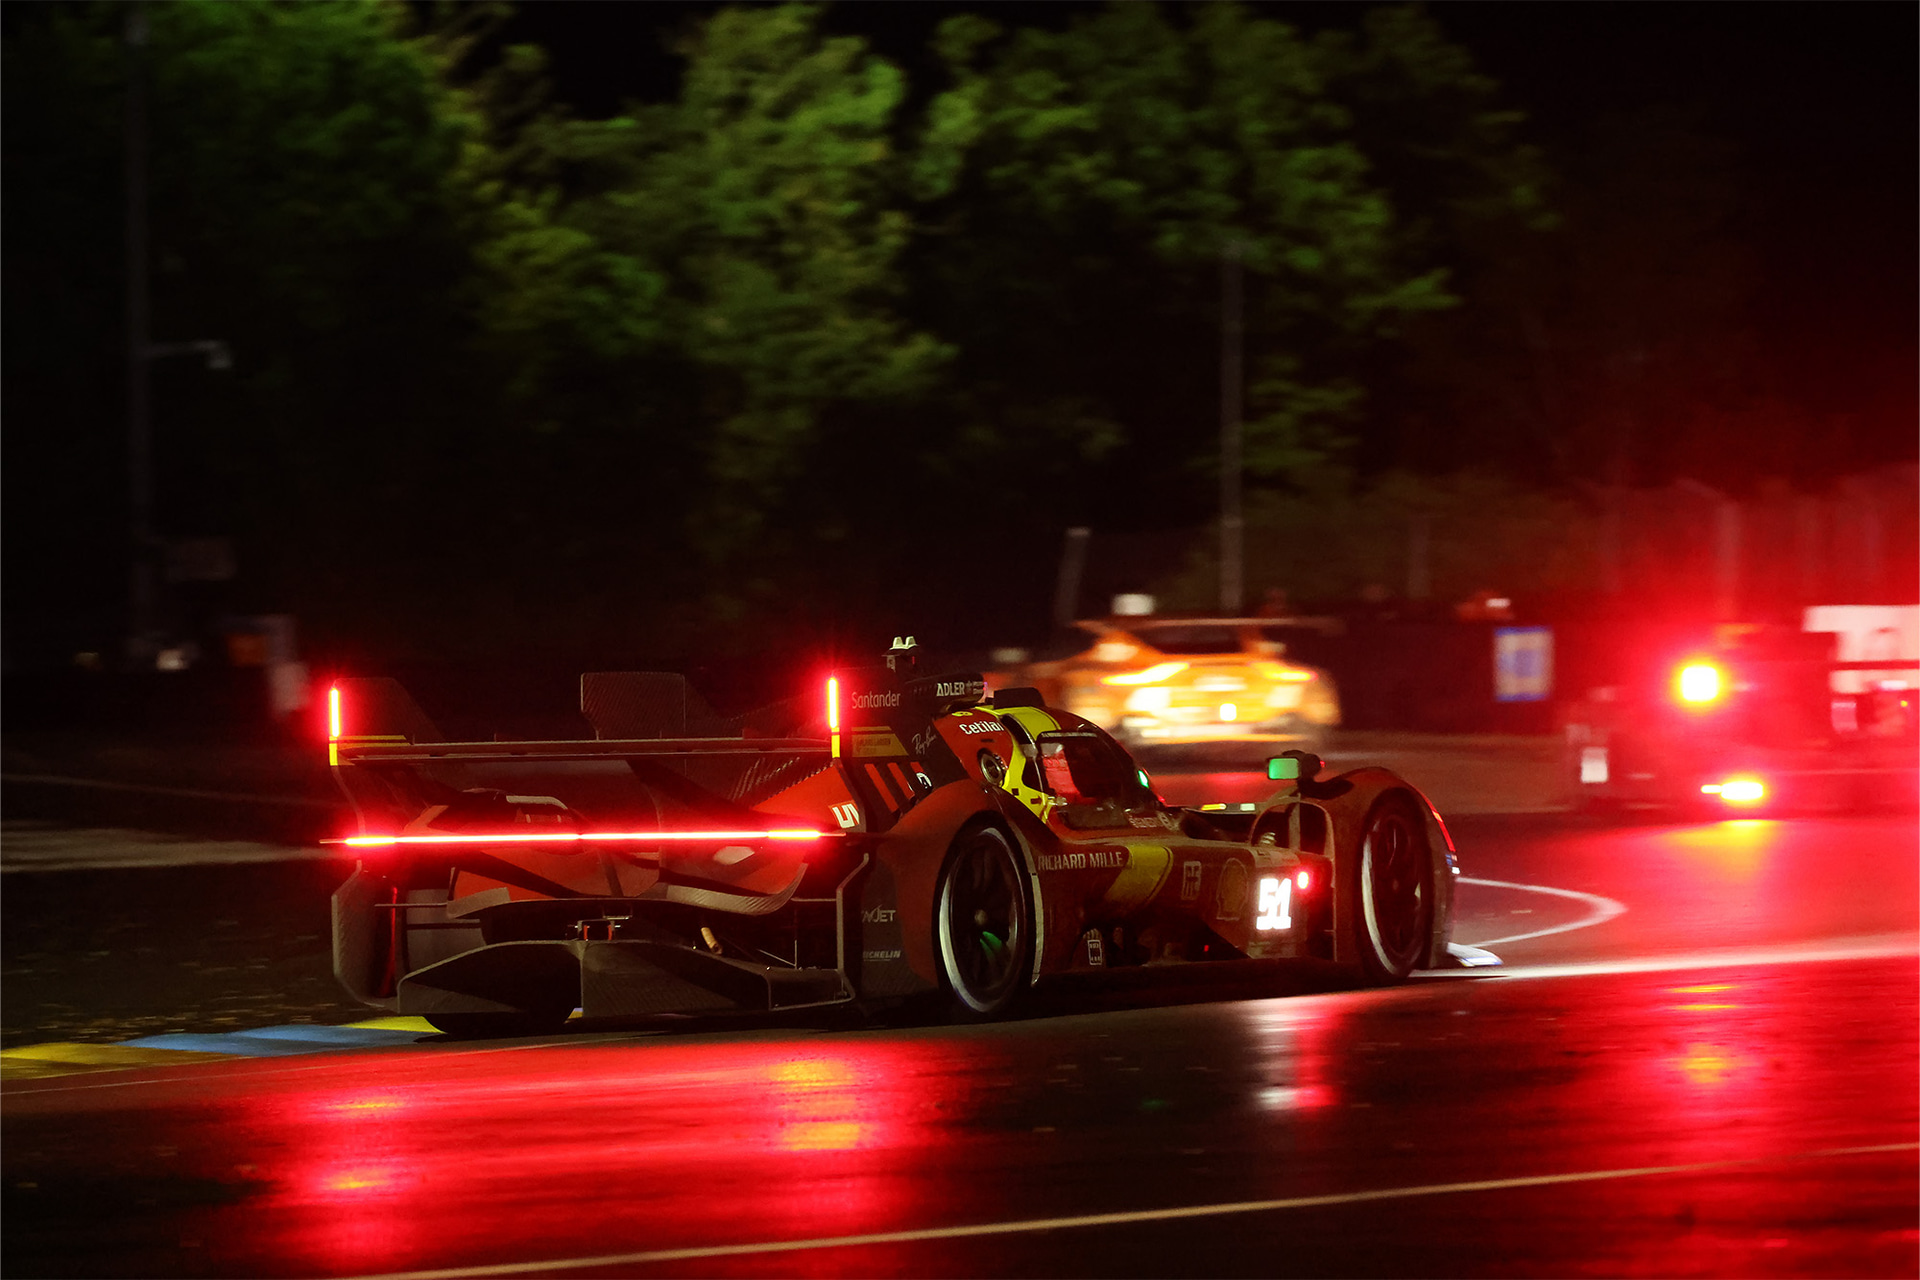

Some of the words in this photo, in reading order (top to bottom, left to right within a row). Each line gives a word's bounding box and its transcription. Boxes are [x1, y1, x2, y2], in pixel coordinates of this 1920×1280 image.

[936, 681, 965, 697] ADLER
[851, 690, 901, 710] Santander
[1037, 853, 1086, 871] RICHARD
[1088, 851, 1124, 869] MILLE
[1256, 878, 1292, 931] 51
